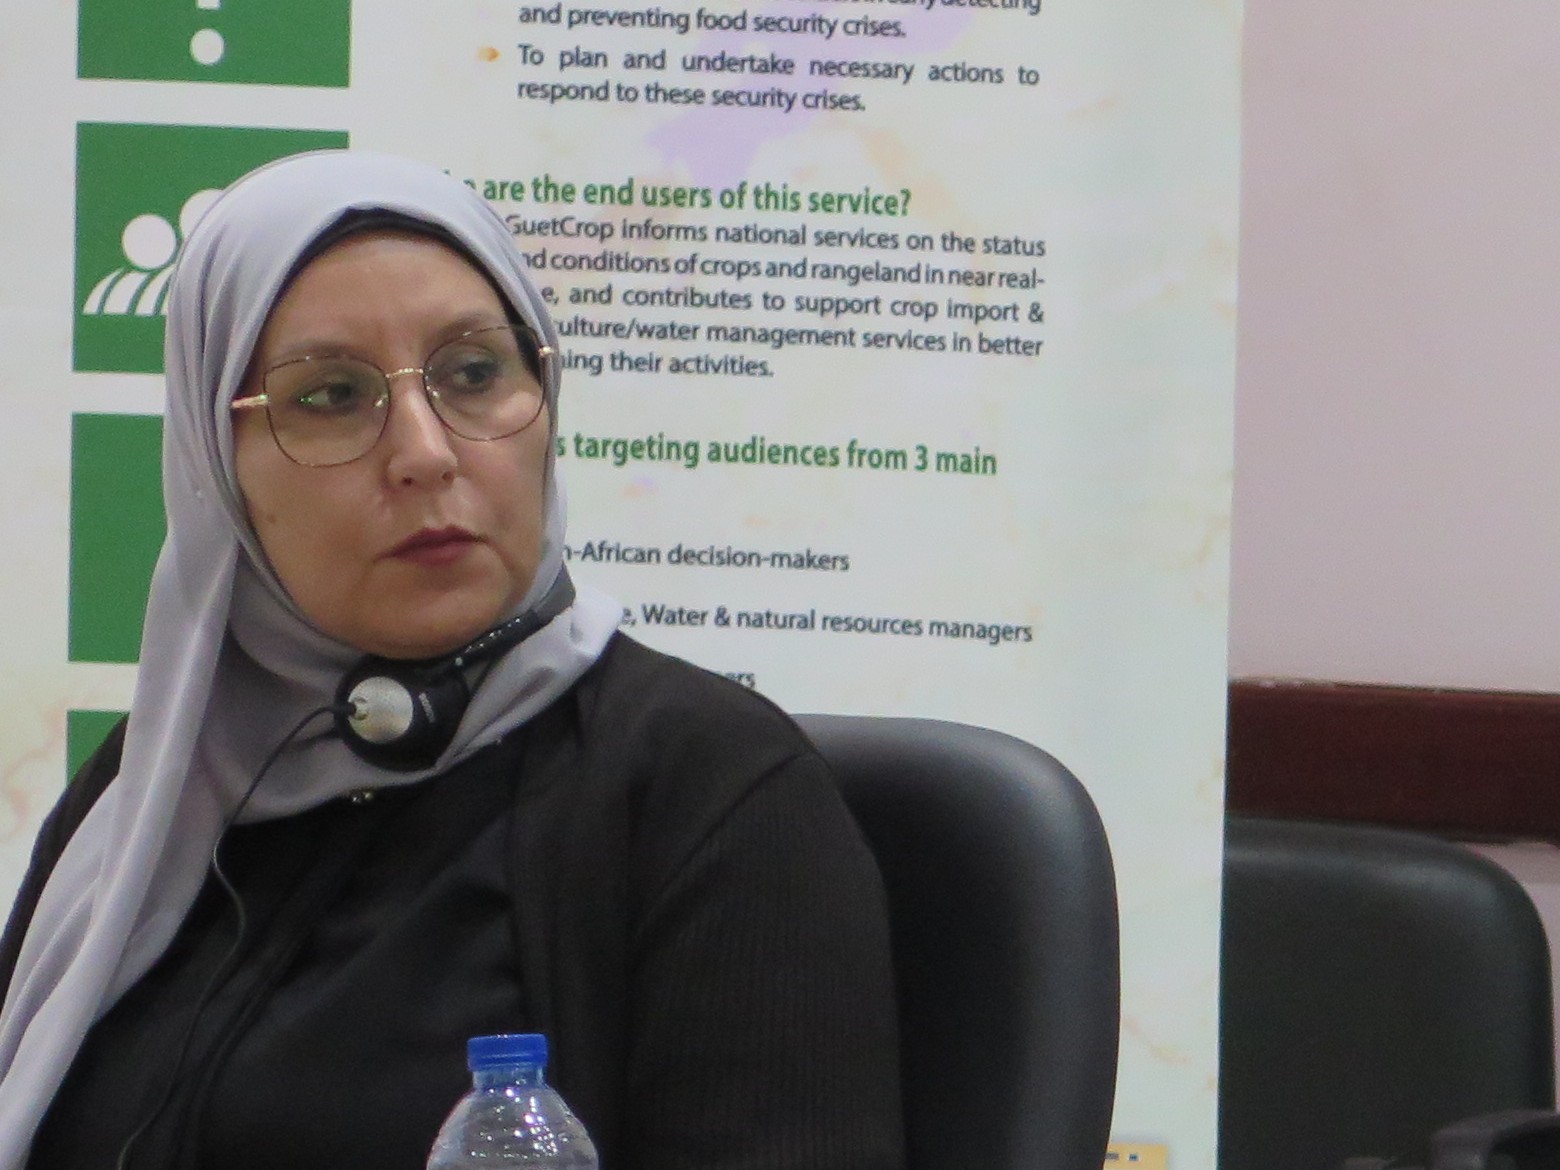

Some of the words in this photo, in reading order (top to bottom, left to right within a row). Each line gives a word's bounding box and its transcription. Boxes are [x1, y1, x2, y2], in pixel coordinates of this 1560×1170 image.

[518, 2, 563, 25] and
[567, 7, 691, 35] preventing
[695, 7, 748, 32] food
[752, 13, 839, 40] security
[842, 15, 907, 38] crises.
[517, 43, 545, 66] To
[559, 45, 609, 72] plan
[623, 48, 667, 71] and
[681, 49, 796, 76] undertake
[809, 59, 915, 85] necessary
[927, 61, 1005, 84] actions
[1017, 65, 1040, 86] to
[517, 79, 610, 105] respond
[615, 82, 640, 103] to
[644, 81, 706, 105] these
[711, 86, 798, 114] security
[801, 88, 866, 112] crises.
[483, 180, 526, 203] are
[531, 173, 577, 205] the
[582, 177, 635, 207] end
[641, 185, 712, 209] users
[719, 180, 748, 210] of
[752, 182, 802, 213] this
[808, 186, 913, 217] service?
[621, 217, 708, 242] informs
[714, 223, 807, 246] national
[813, 227, 900, 250] services
[905, 234, 934, 251] on
[940, 230, 977, 255] the
[982, 235, 1046, 257] status
[524, 248, 547, 272] nd
[549, 249, 672, 274] conditions
[673, 252, 699, 275] of
[699, 259, 762, 281] crops
[764, 257, 808, 279] and
[810, 260, 922, 287] rangeland
[924, 263, 945, 285] in
[947, 269, 996, 288] near
[997, 267, 1045, 290] real-
[568, 283, 613, 305] and
[622, 286, 753, 310] contributes
[761, 291, 786, 311] to
[794, 295, 882, 319] support
[890, 299, 939, 323] crop
[947, 298, 1020, 326] import
[1027, 301, 1045, 323] &
[558, 316, 700, 342] ulture/water
[706, 325, 856, 350] management
[862, 329, 947, 352] services
[952, 331, 972, 353] in
[978, 331, 1044, 357] better
[609, 349, 664, 374] their
[668, 354, 774, 377] activities.
[573, 432, 700, 470] targeting
[706, 435, 841, 468] audiences
[846, 438, 908, 471] from
[914, 444, 929, 473] 3
[935, 446, 998, 476] main
[564, 538, 661, 564] -African
[666, 543, 850, 572] decision-makers
[641, 604, 709, 626] Water
[713, 605, 731, 628] &
[736, 608, 816, 631] natural
[821, 614, 924, 636] resources
[928, 620, 1033, 647] managers
